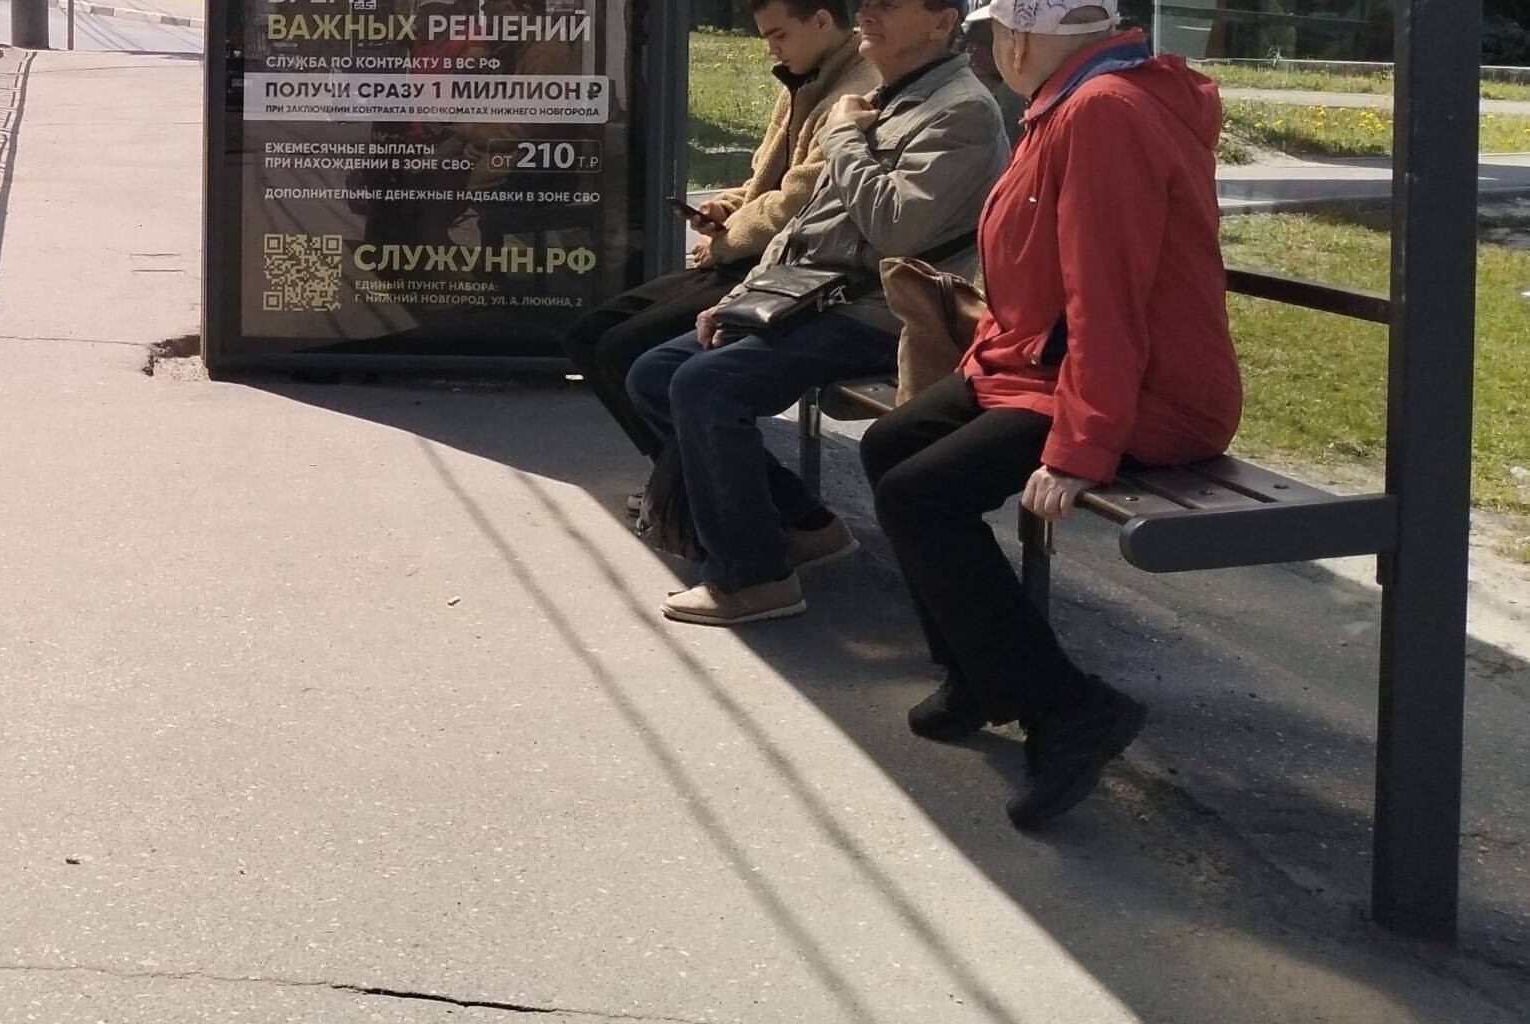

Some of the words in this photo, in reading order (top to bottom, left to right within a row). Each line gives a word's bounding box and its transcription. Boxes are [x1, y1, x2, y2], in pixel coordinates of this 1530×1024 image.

[267, 14, 416, 40] ВАЖНЫХ
[428, 10, 591, 42] РЕШЕНИЙ
[266, 56, 327, 69] СЛУЖБА
[331, 57, 352, 69] ПО
[356, 57, 439, 70] КОНТРАКТУ
[443, 58, 452, 69] В
[456, 58, 475, 70] ВС
[480, 58, 501, 71] РФ
[265, 82, 350, 98] ПОЛУЧИ
[358, 82, 424, 99] СРАЗУ
[432, 81, 441, 99] 1
[451, 81, 581, 100] МИЛЛИОН
[265, 105, 284, 113] ПРИ
[353, 106, 407, 114] КОНТРАКТА
[417, 106, 488, 115] ВОЕНКОМАТАХ
[491, 107, 537, 116] НИЖНЕГО
[541, 108, 599, 117] НОВГОРОДА
[265, 143, 366, 155] ЕЖЕМЕСЯЧНЫЕ
[369, 144, 435, 155] ВЫПЛАТЫ
[491, 155, 512, 167] ОТ
[516, 142, 575, 169] 210
[265, 157, 292, 169] ПРИ
[294, 158, 388, 171] НАХОЖДЕНИИ
[391, 159, 400, 169] В
[404, 159, 438, 170] ЗОНЕ
[442, 159, 475, 170] СВО:
[265, 188, 382, 200] ДОПОЛНИТЕЛЬНЫЕ
[385, 190, 453, 201] ДЕНЕЖНЫЕ
[456, 191, 523, 202] НАДБАВКИ
[526, 192, 534, 202] В
[538, 192, 570, 202] ЗОНЕ
[573, 192, 600, 202] СВО
[353, 244, 597, 275] СЛУЖУНН.РФ
[355, 278, 405, 290] ЕДИНЫЙ
[408, 281, 446, 291] ПУНКТ
[449, 281, 499, 292] НАБОРА:
[354, 294, 363, 303] Г.
[366, 291, 418, 303] НИЖНИЙ
[491, 296, 507, 305] УЛ.
[575, 298, 583, 307] 2
